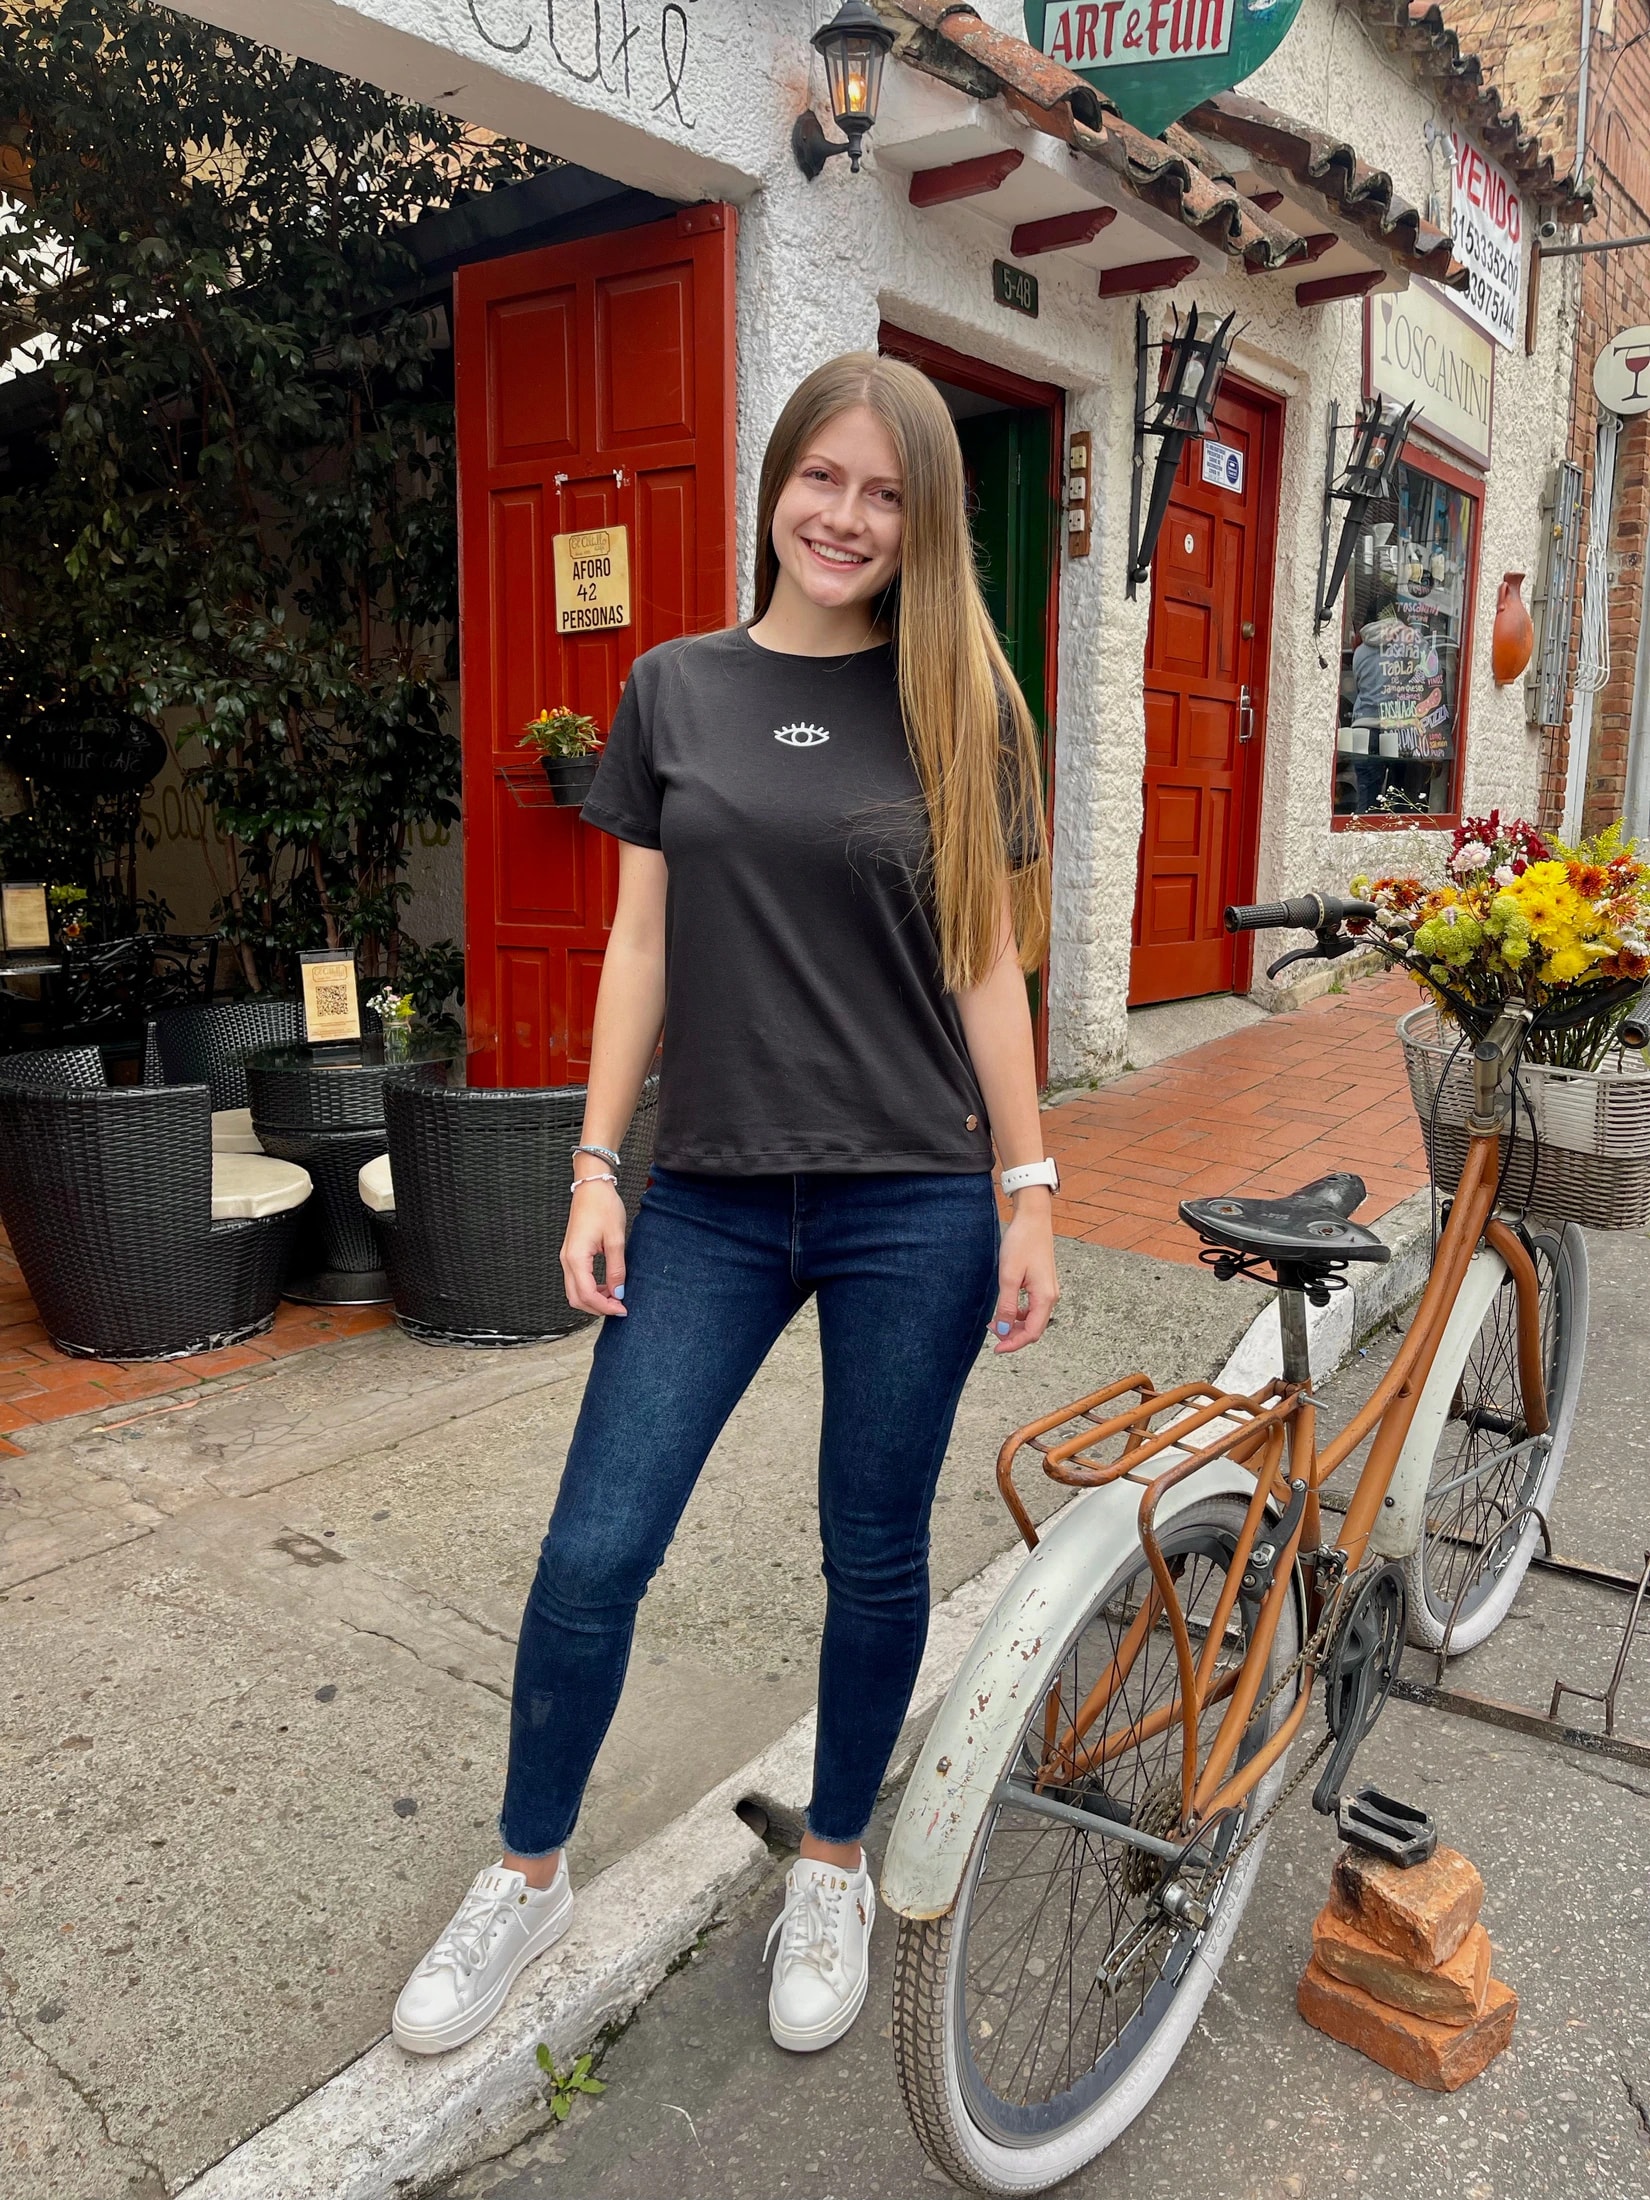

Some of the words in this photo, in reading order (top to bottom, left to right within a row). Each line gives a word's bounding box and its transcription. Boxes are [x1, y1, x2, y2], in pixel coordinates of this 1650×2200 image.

[1452, 132, 1520, 244] VENDO
[1003, 268, 1031, 309] 5-48
[1461, 263, 1515, 338] 3975144
[573, 557, 611, 580] AFORO
[577, 583, 597, 602] 42
[562, 605, 624, 629] PERSONAS
[1421, 704, 1450, 733] PIZZA
